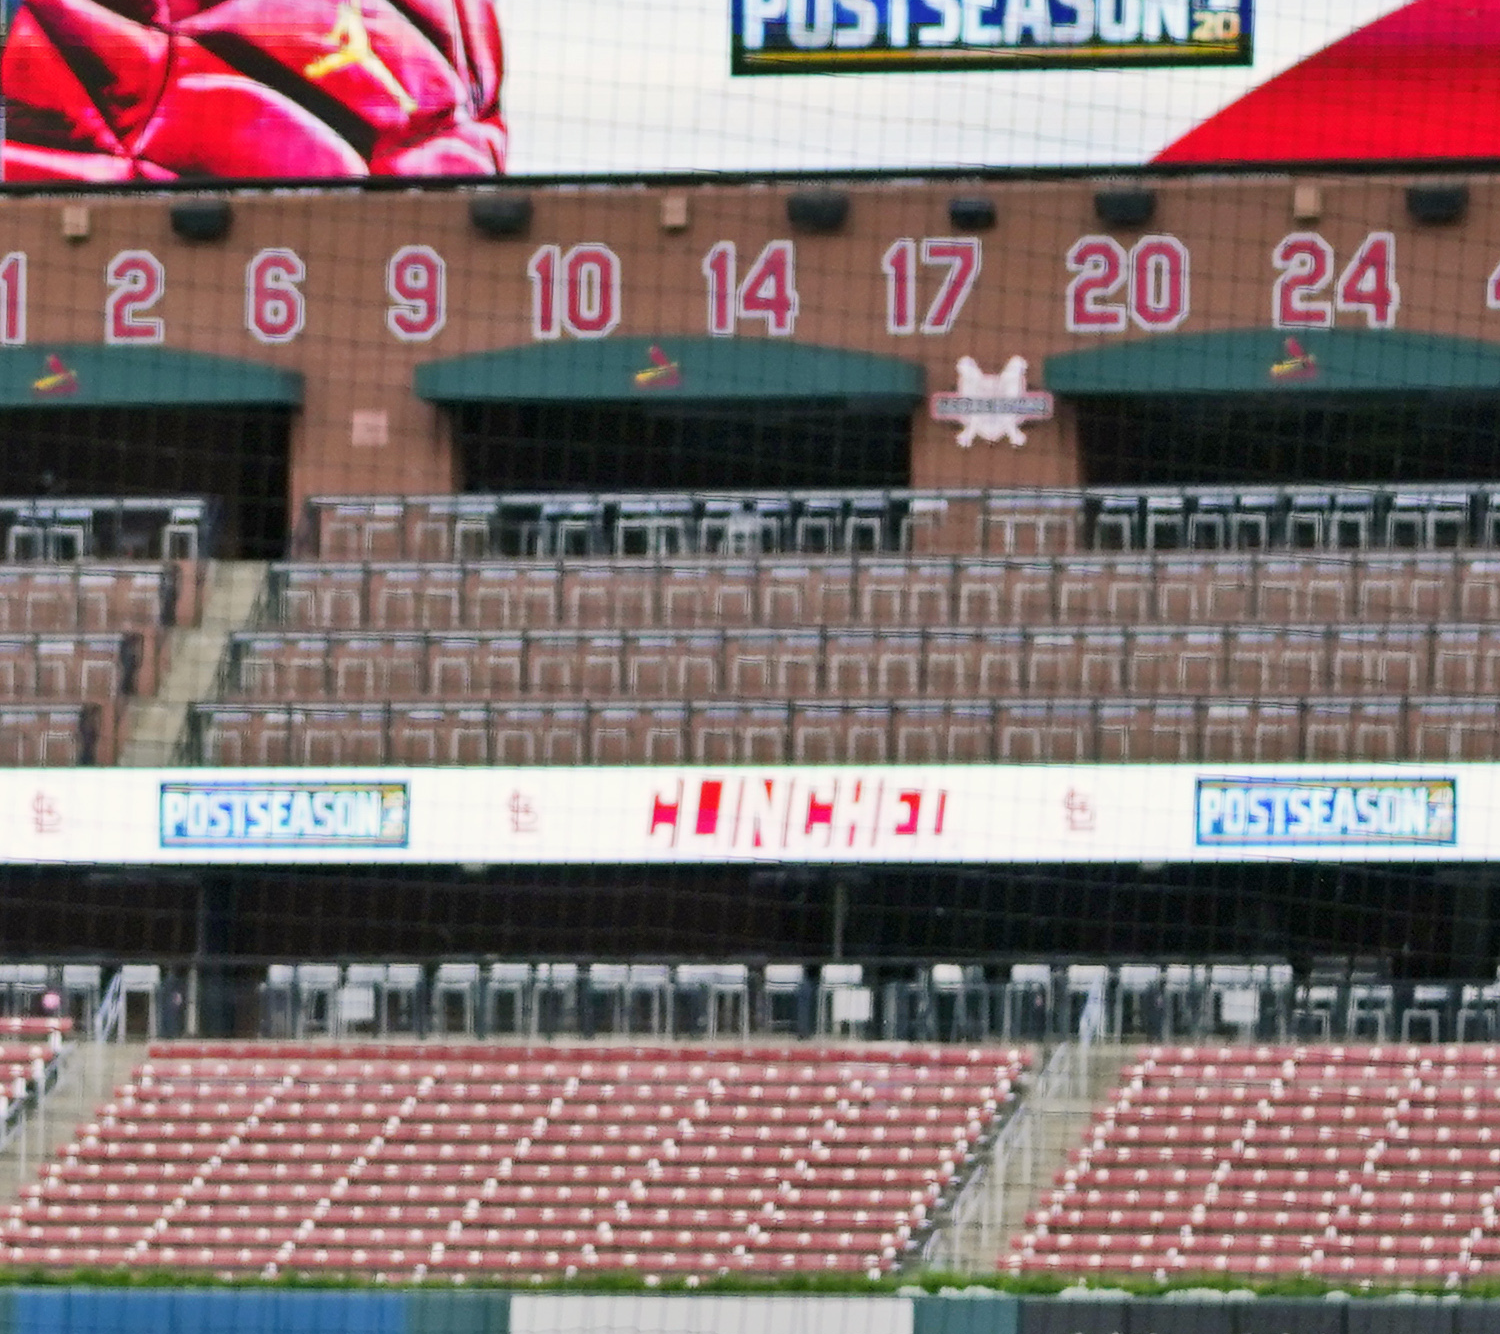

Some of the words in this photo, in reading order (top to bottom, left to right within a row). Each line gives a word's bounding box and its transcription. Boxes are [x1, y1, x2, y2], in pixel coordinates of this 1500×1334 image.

[105, 249, 165, 344] 2
[246, 247, 305, 342] 6
[387, 244, 446, 340] 9
[527, 242, 622, 338] 10
[703, 239, 798, 336] 14
[883, 237, 982, 334] 17
[1067, 234, 1189, 332] 20
[1272, 232, 1398, 329] 24
[165, 790, 383, 838] POSTSEASON
[1200, 785, 1425, 837] POSTSEASON
